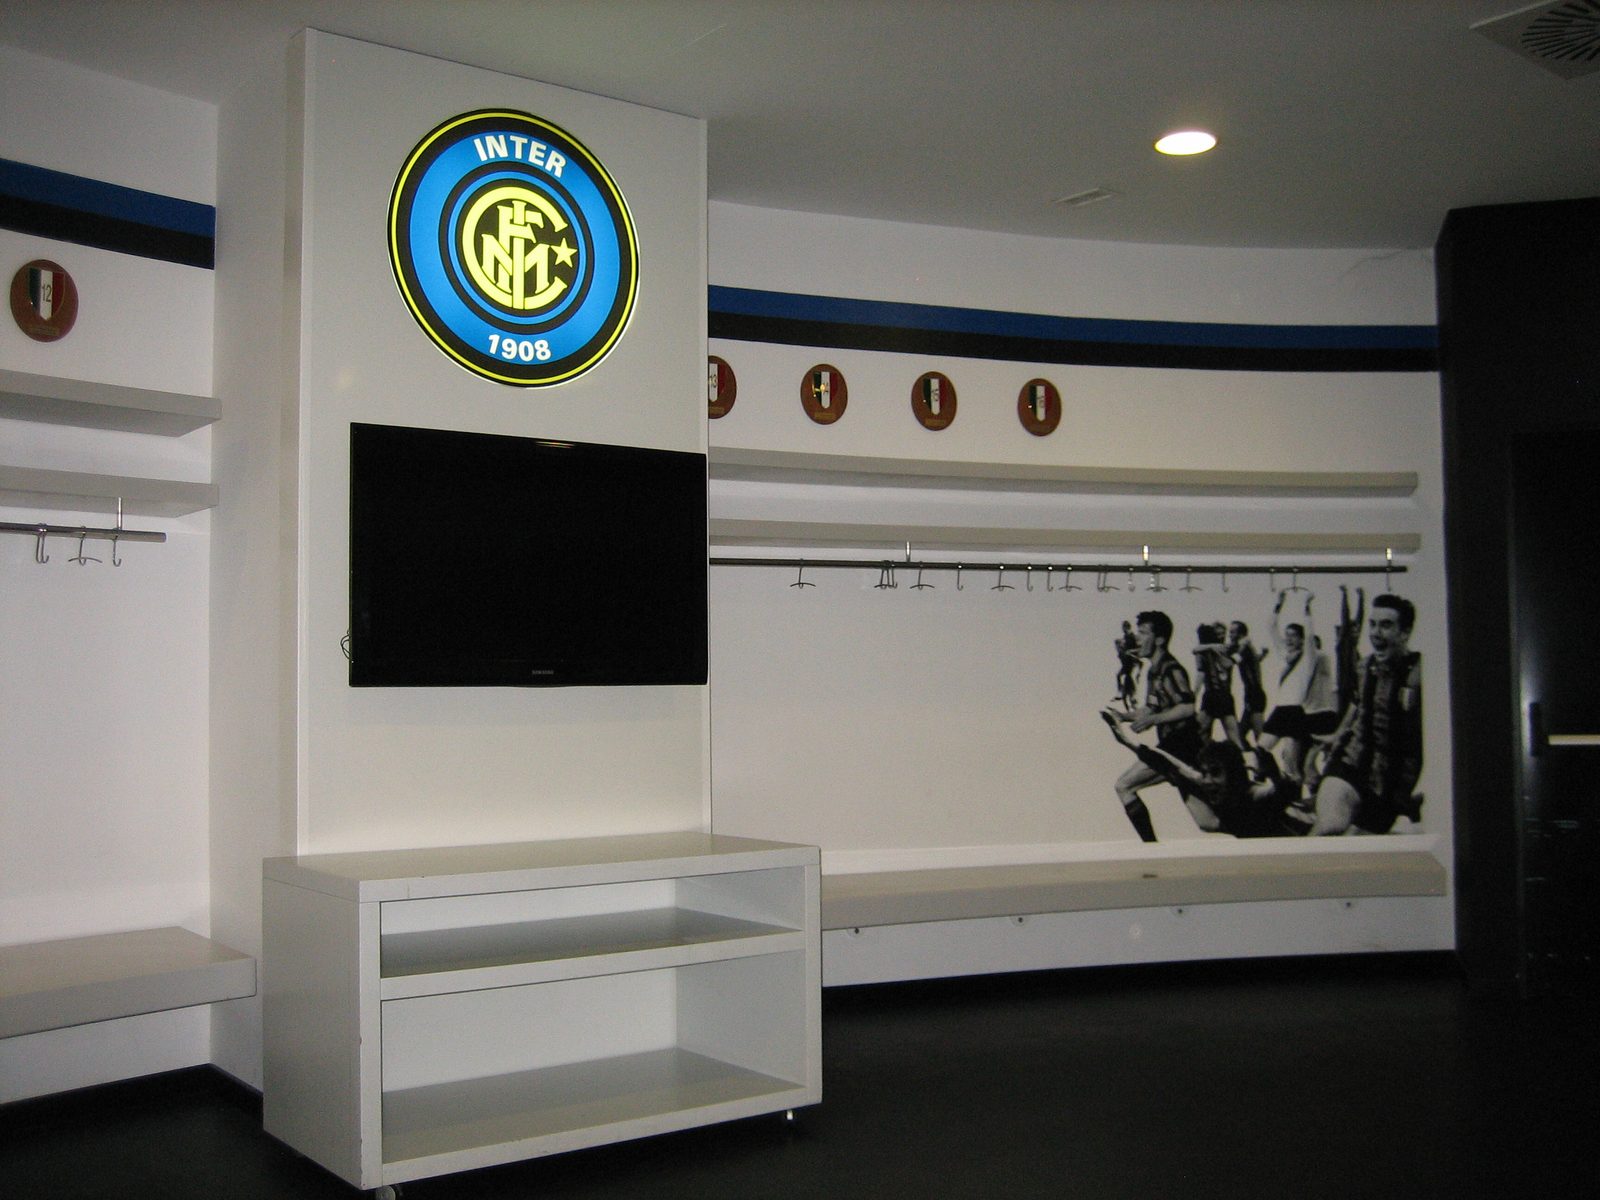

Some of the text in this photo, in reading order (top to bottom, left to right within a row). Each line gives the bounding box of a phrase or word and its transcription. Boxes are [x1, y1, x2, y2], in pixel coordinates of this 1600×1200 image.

[473, 134, 567, 178] INTER
[42, 283, 52, 302] 12
[488, 334, 551, 361] 1908
